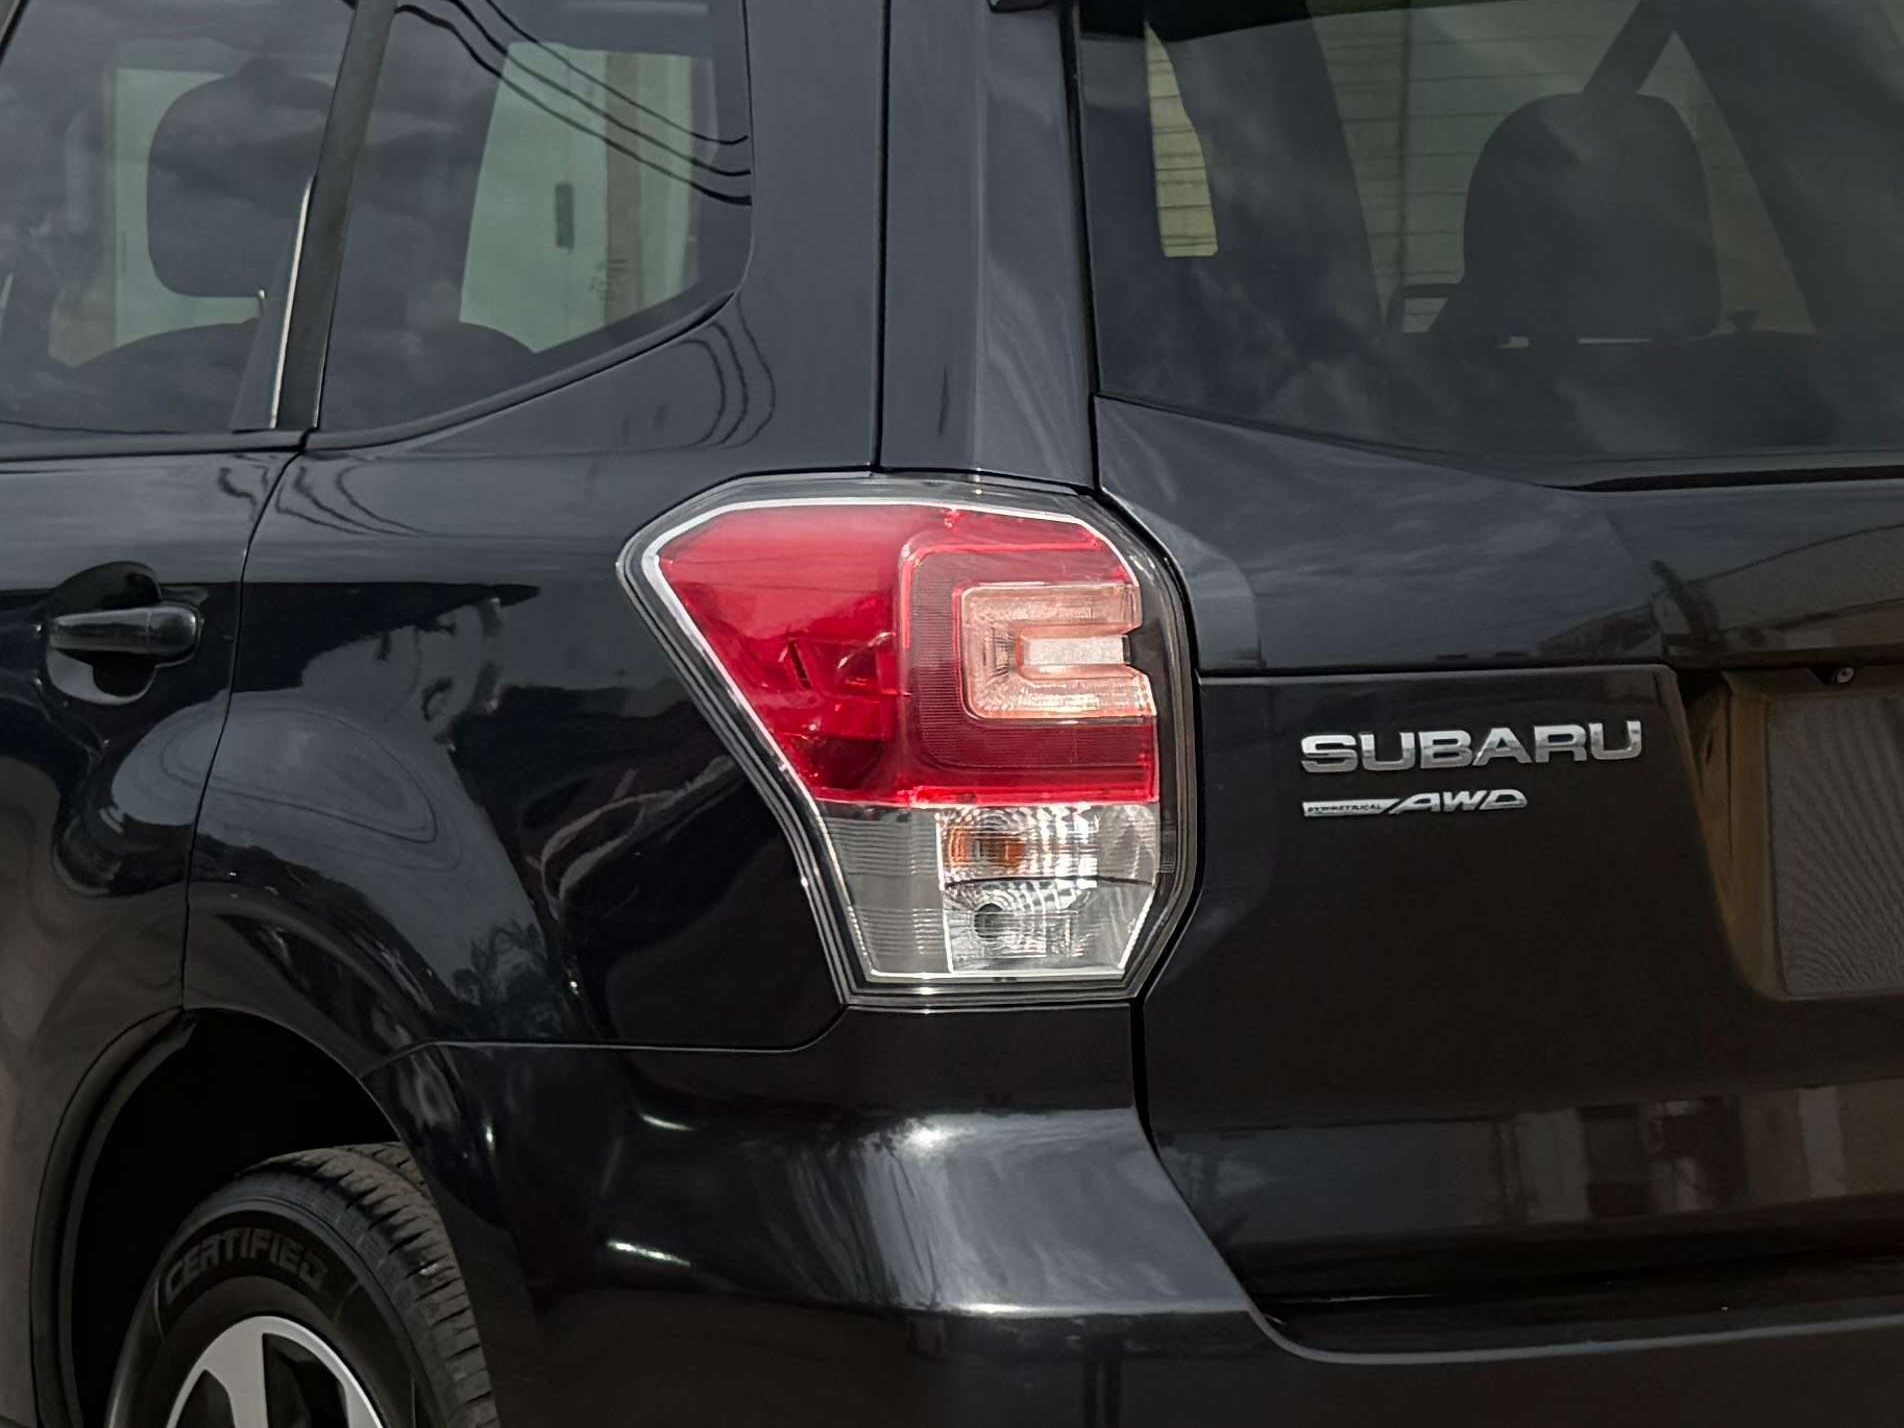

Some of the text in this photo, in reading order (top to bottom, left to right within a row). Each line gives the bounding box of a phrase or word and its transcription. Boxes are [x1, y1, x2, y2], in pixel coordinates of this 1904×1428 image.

[1301, 720, 1643, 773] SUBARU
[1389, 789, 1528, 815] AWD
[165, 1227, 329, 1305] CERTIFIED
